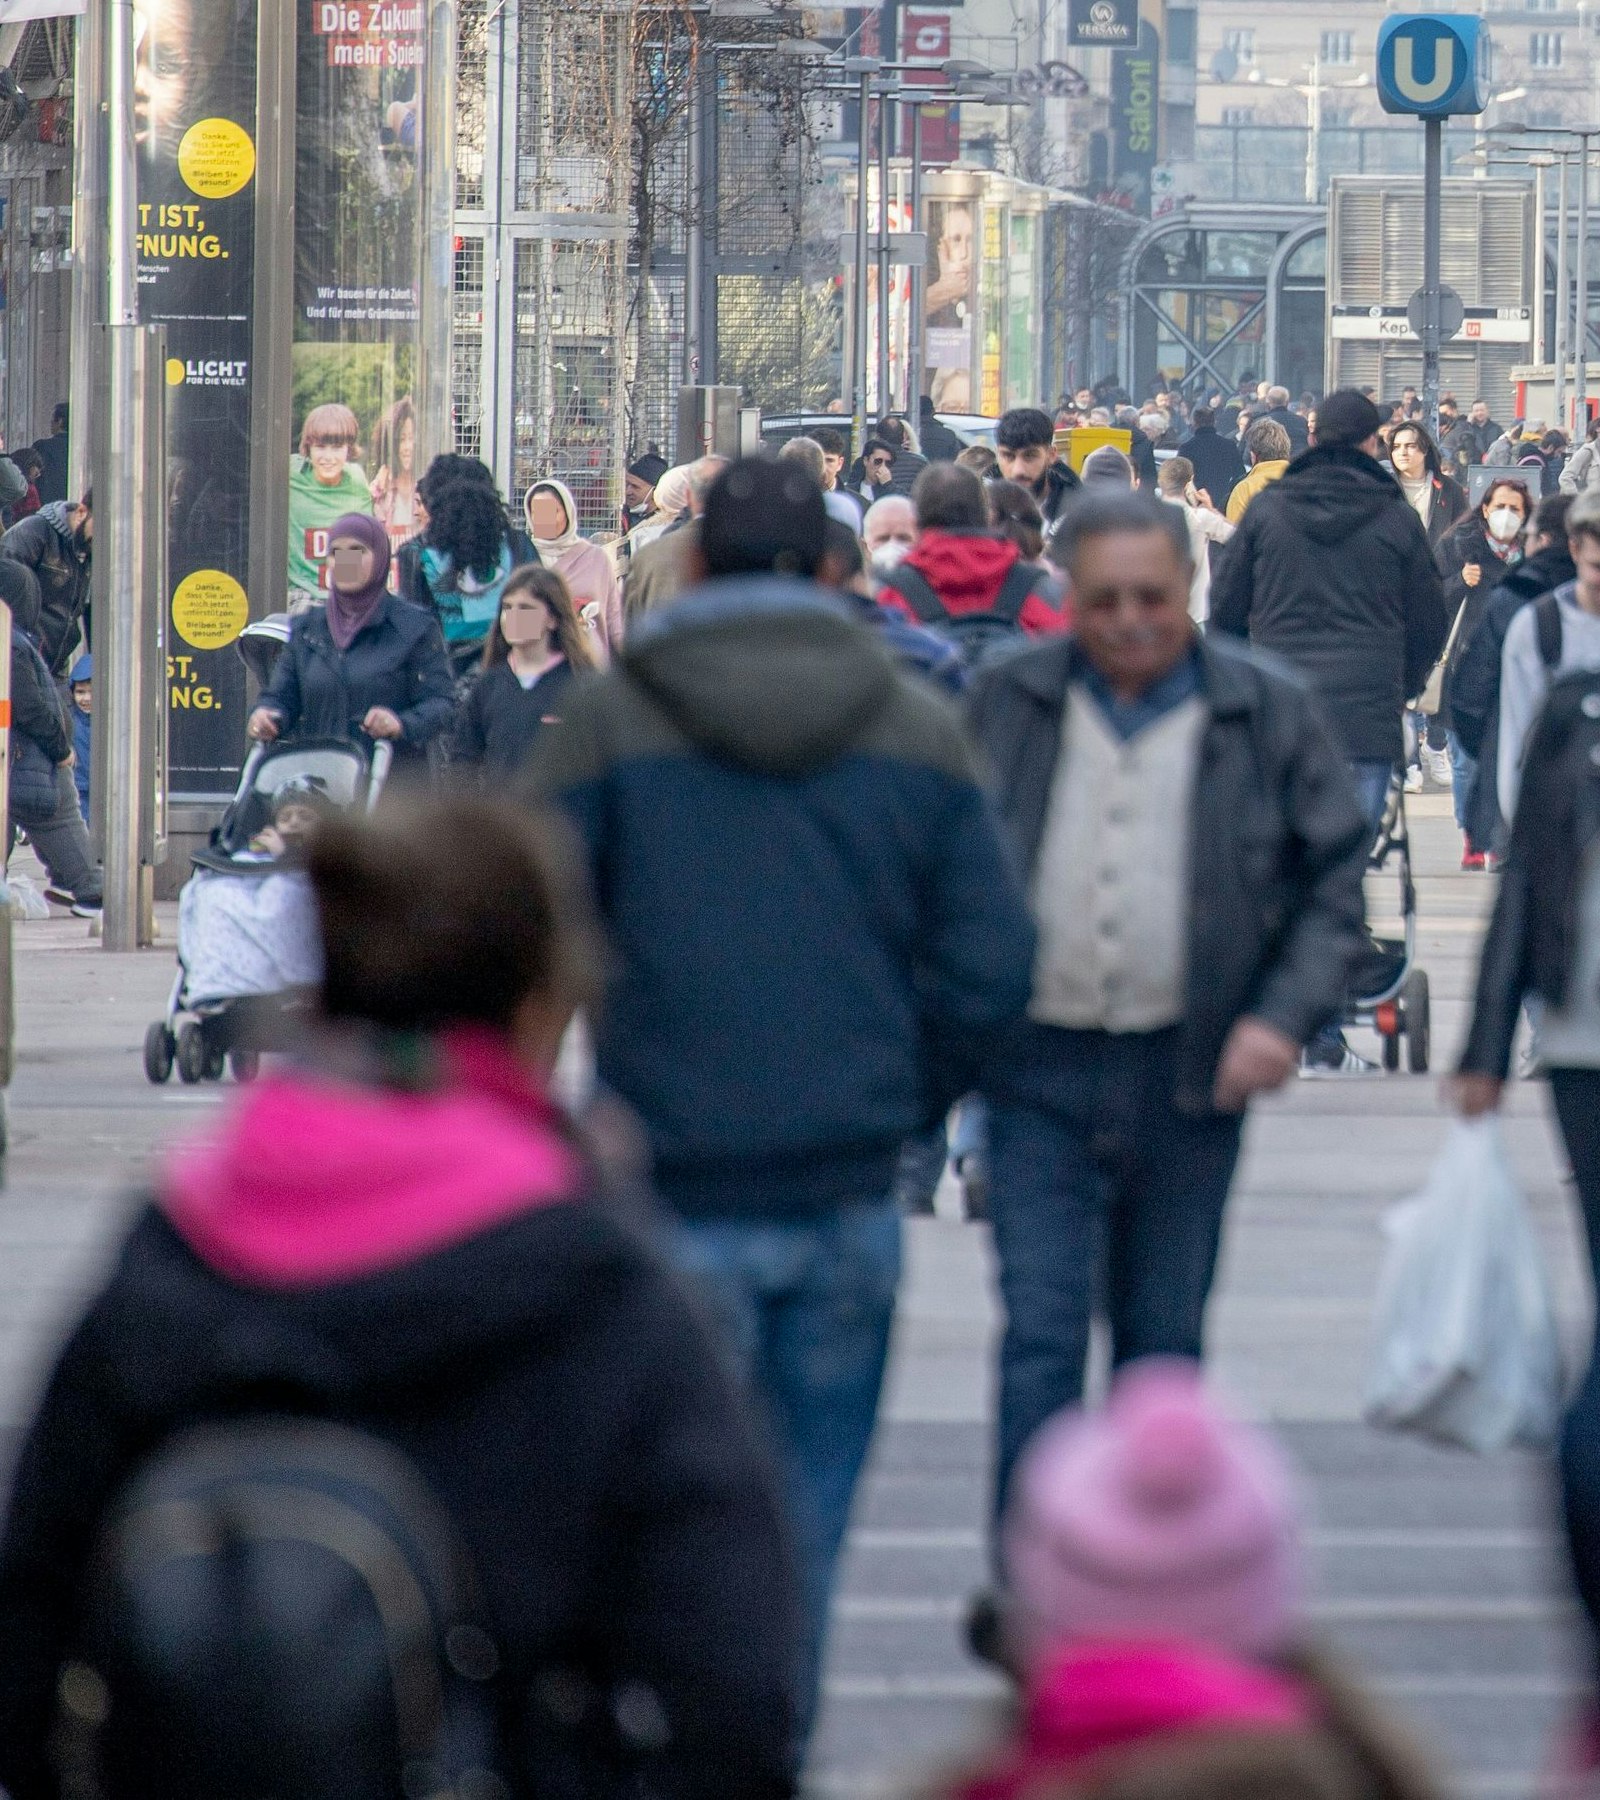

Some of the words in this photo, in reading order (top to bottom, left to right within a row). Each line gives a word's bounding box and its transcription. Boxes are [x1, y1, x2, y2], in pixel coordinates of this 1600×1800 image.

[321, 4, 360, 32] Die
[334, 41, 383, 65] mehr
[1394, 37, 1454, 102] U
[1124, 59, 1152, 153] saloni
[159, 204, 205, 232] IST,
[317, 287, 336, 299] Wir
[306, 306, 326, 318] Und
[186, 360, 247, 377] LICHT
[186, 377, 203, 385] FÜR
[205, 378, 219, 386] DIE
[221, 378, 246, 386] WELT
[172, 686, 222, 710] NG.
